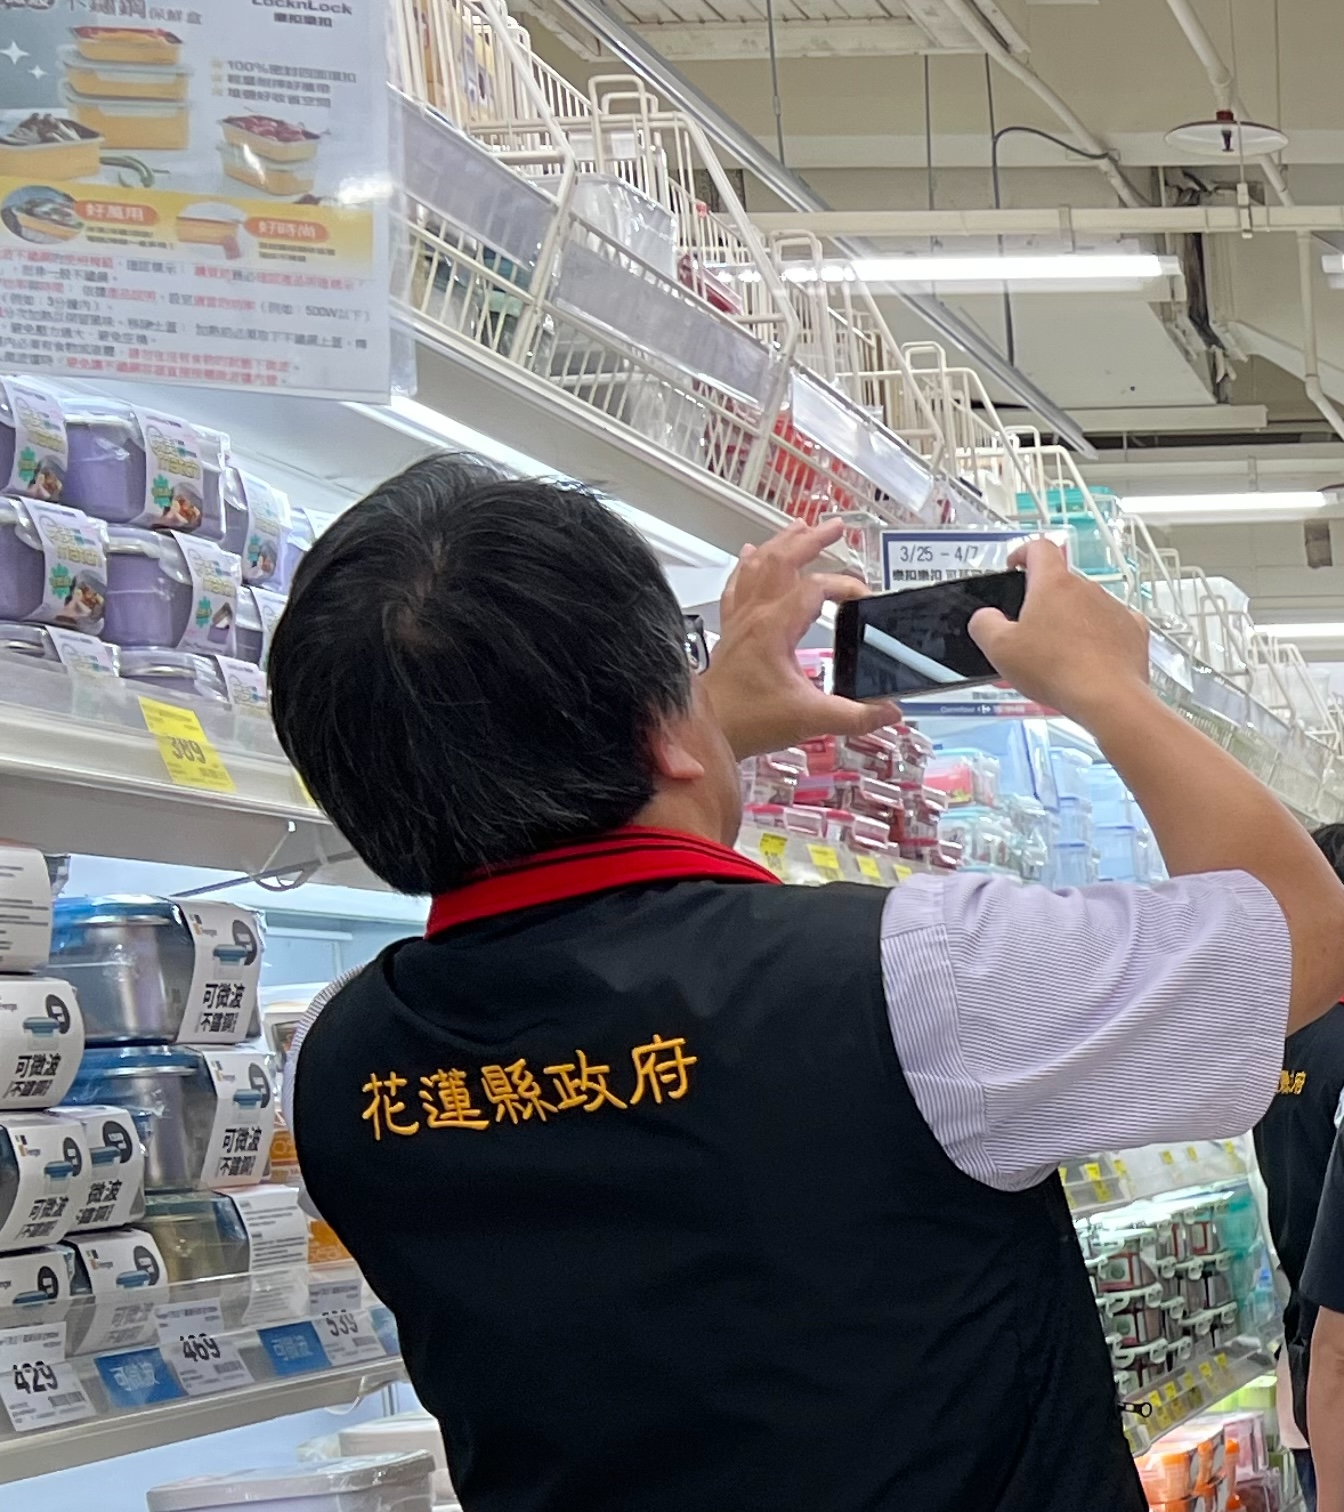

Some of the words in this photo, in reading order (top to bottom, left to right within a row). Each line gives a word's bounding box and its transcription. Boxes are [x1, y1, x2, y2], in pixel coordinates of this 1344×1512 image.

[900, 545, 933, 562] 3/25
[954, 545, 979, 562] 4/7
[202, 983, 246, 1009] 可微波
[15, 1054, 62, 1078] 可微波
[362, 1033, 698, 1141] 花蓮縣政府
[222, 1128, 263, 1153] 可微波
[28, 1197, 70, 1220] 可微波
